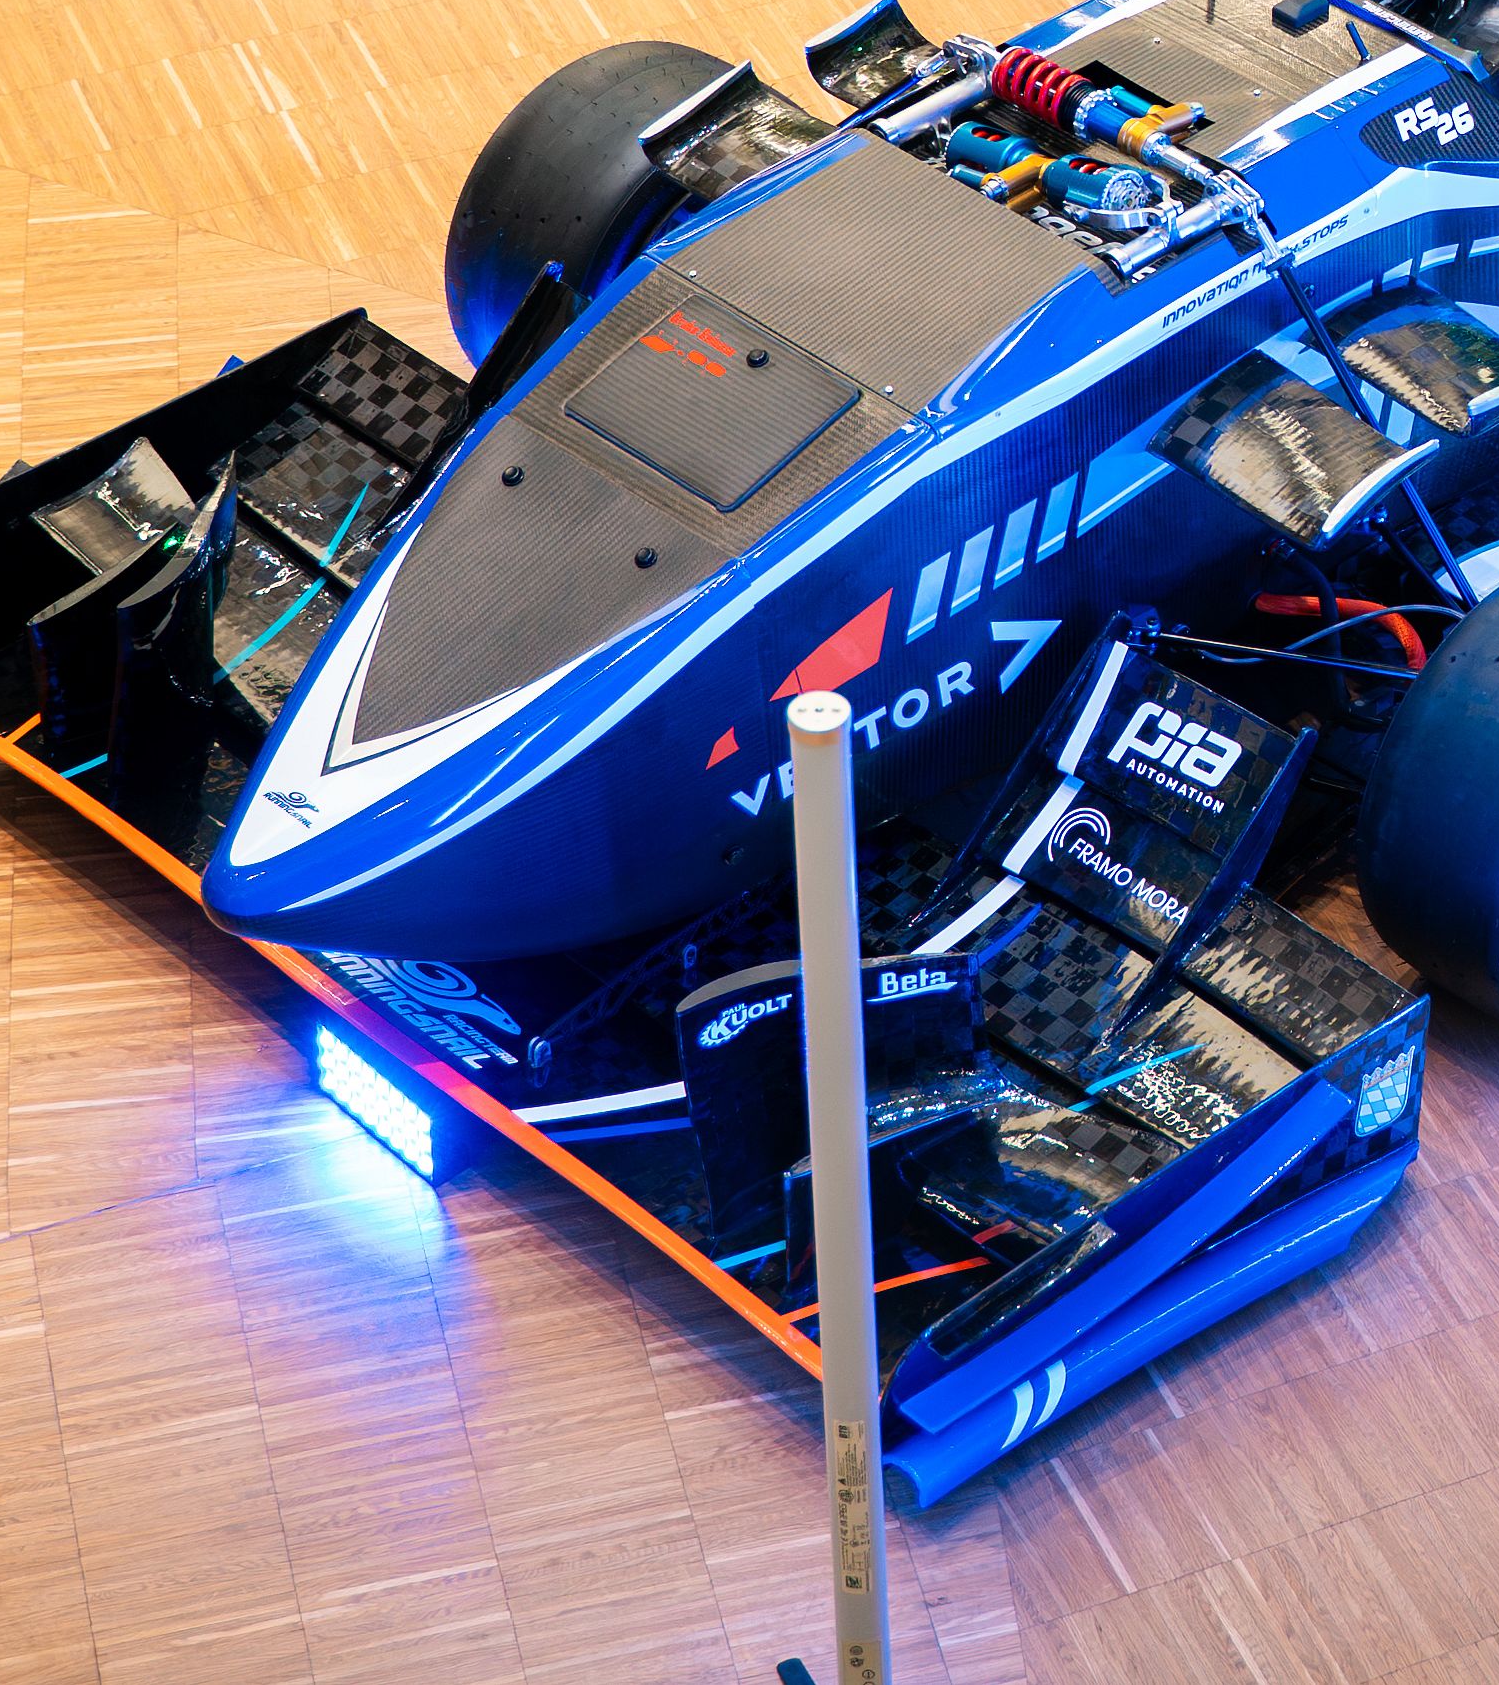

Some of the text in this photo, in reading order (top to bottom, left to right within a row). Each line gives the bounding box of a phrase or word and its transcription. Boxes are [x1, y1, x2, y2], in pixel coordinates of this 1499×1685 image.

[1394, 97, 1475, 146] RS 26
[1302, 214, 1349, 251] STOPS
[731, 619, 1062, 816] VETOR 7
[1126, 758, 1225, 814] AUTOMATION
[1068, 837, 1190, 926] FRAMO MORA
[882, 968, 947, 995] Beta
[322, 951, 491, 1069] NNINGSNAIL
[709, 993, 793, 1040] KUOLT
[722, 1003, 747, 1017] PAUL
